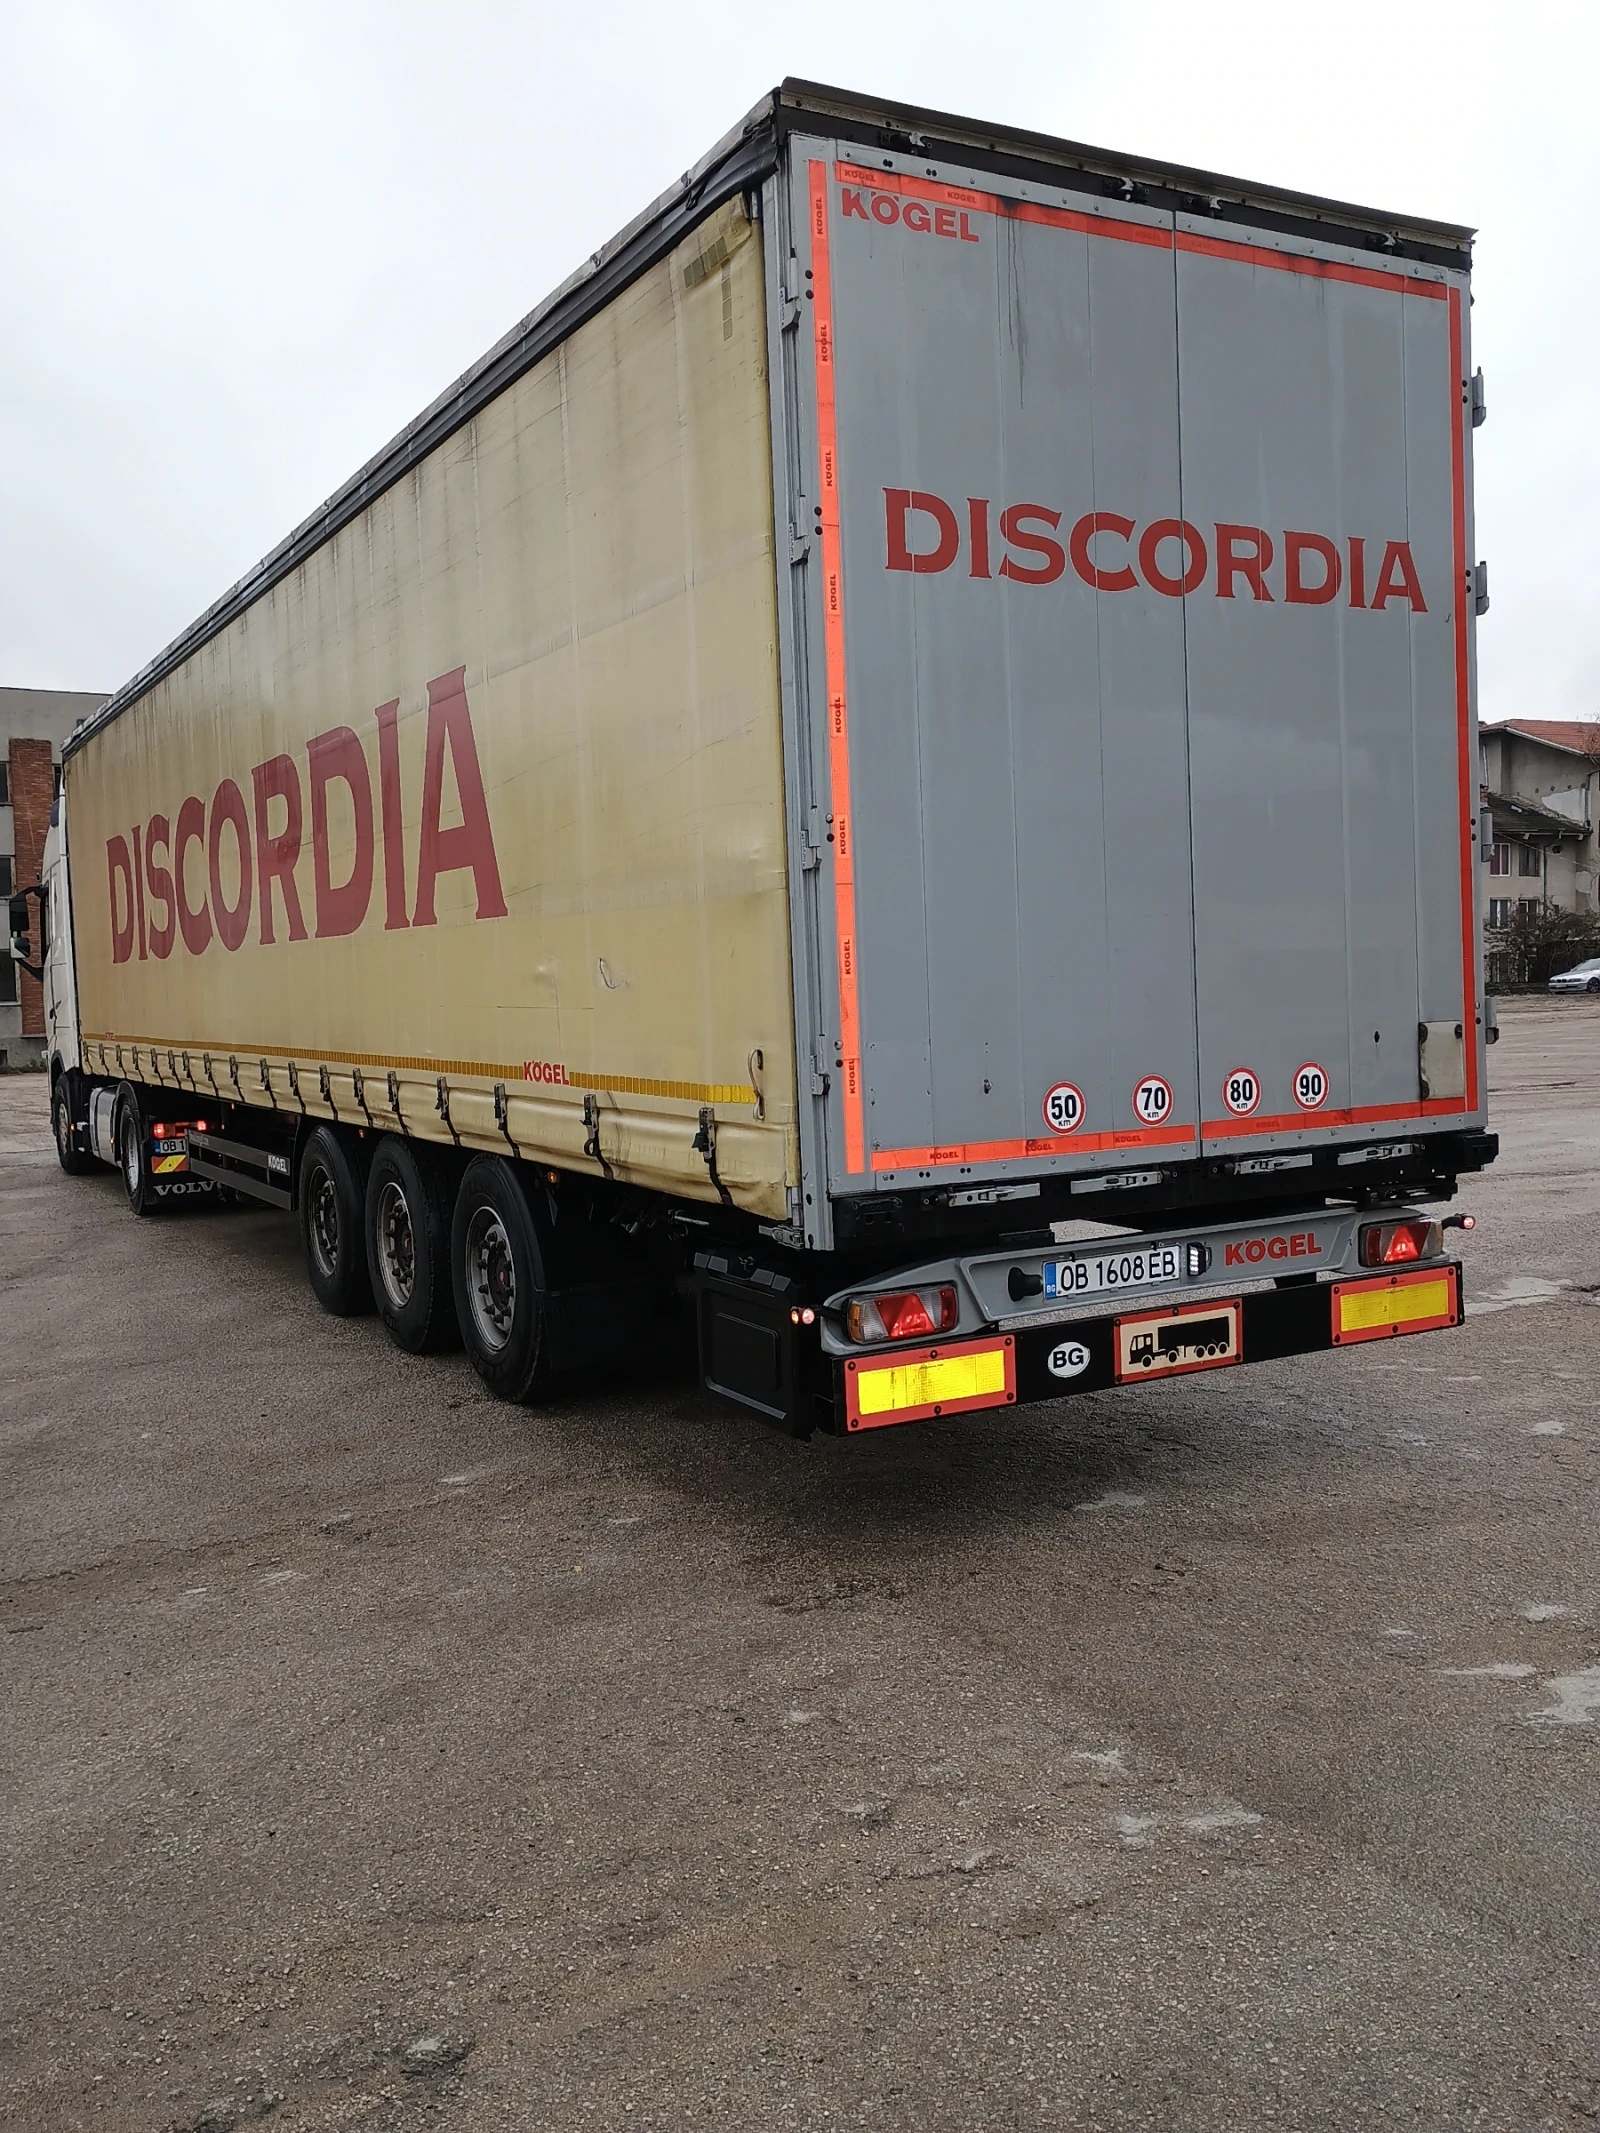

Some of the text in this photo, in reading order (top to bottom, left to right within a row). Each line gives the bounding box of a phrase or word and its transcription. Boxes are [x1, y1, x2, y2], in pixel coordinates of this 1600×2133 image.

[844, 168, 876, 183] KÖGEL
[946, 190, 978, 205] KÖGEL
[816, 196, 824, 236] KÖGEL
[841, 187, 980, 243] KÖGEL
[821, 323, 829, 363] KÖGEL
[881, 486, 1429, 613] DISCORDIA
[830, 573, 838, 611] KÖGEL
[106, 663, 509, 964] DISCORDIA
[523, 1060, 570, 1086] KÖGEL
[1299, 1073, 1322, 1097] 90
[1141, 1086, 1166, 1111] 70
[1230, 1078, 1253, 1102] 80
[1051, 1094, 1077, 1120] 50
[162, 1140, 177, 1152] OB
[1115, 1134, 1142, 1144] KÖGEL
[929, 1150, 959, 1161] KÖGEL
[1225, 1233, 1322, 1267] KÖGEL
[1060, 1250, 1176, 1291] OB 1608 EB
[1046, 1284, 1056, 1293] BG
[1053, 1347, 1084, 1369] BG
